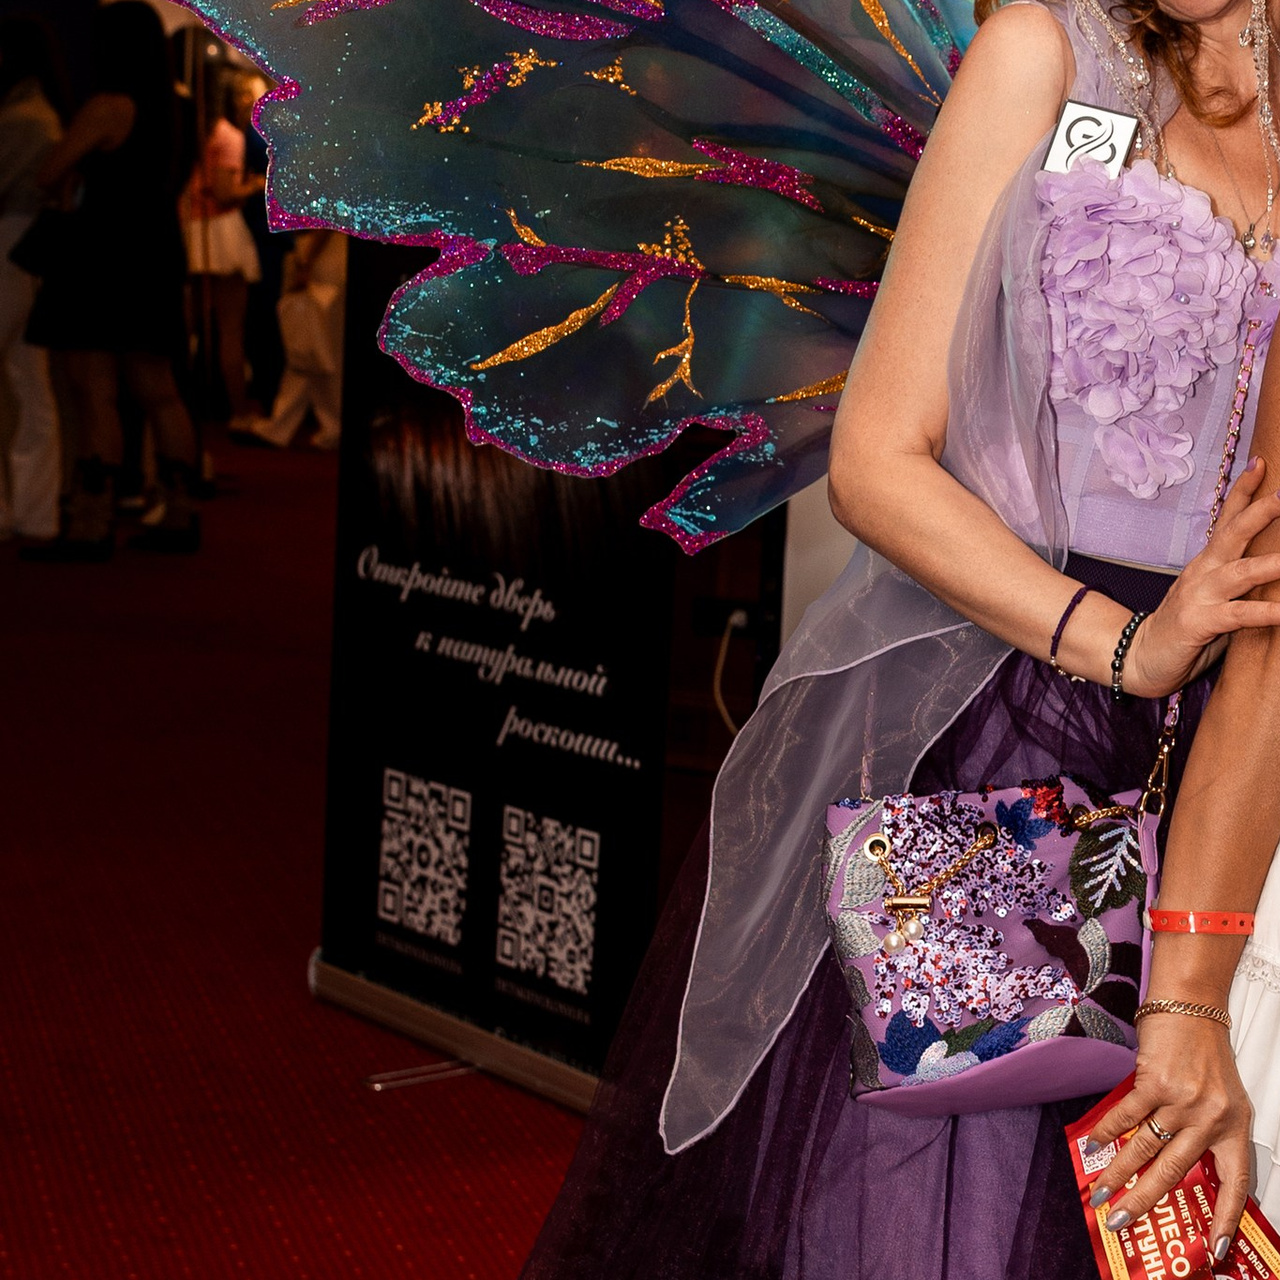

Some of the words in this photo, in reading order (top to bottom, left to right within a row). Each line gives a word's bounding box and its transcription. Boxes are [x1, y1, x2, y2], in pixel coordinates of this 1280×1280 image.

[356, 544, 486, 602] Откройте
[489, 572, 556, 631] дверь
[415, 631, 433, 652] к
[436, 637, 608, 697] натуральной
[496, 705, 641, 770] роскоши...
[1175, 1188, 1193, 1225] БИЛЕТ
[1185, 1226, 1197, 1244] НА
[1193, 1184, 1214, 1219] БИЛЕТ
[1154, 1192, 1191, 1278] ЛЕСО
[1247, 1250, 1270, 1280] СТЕНД
